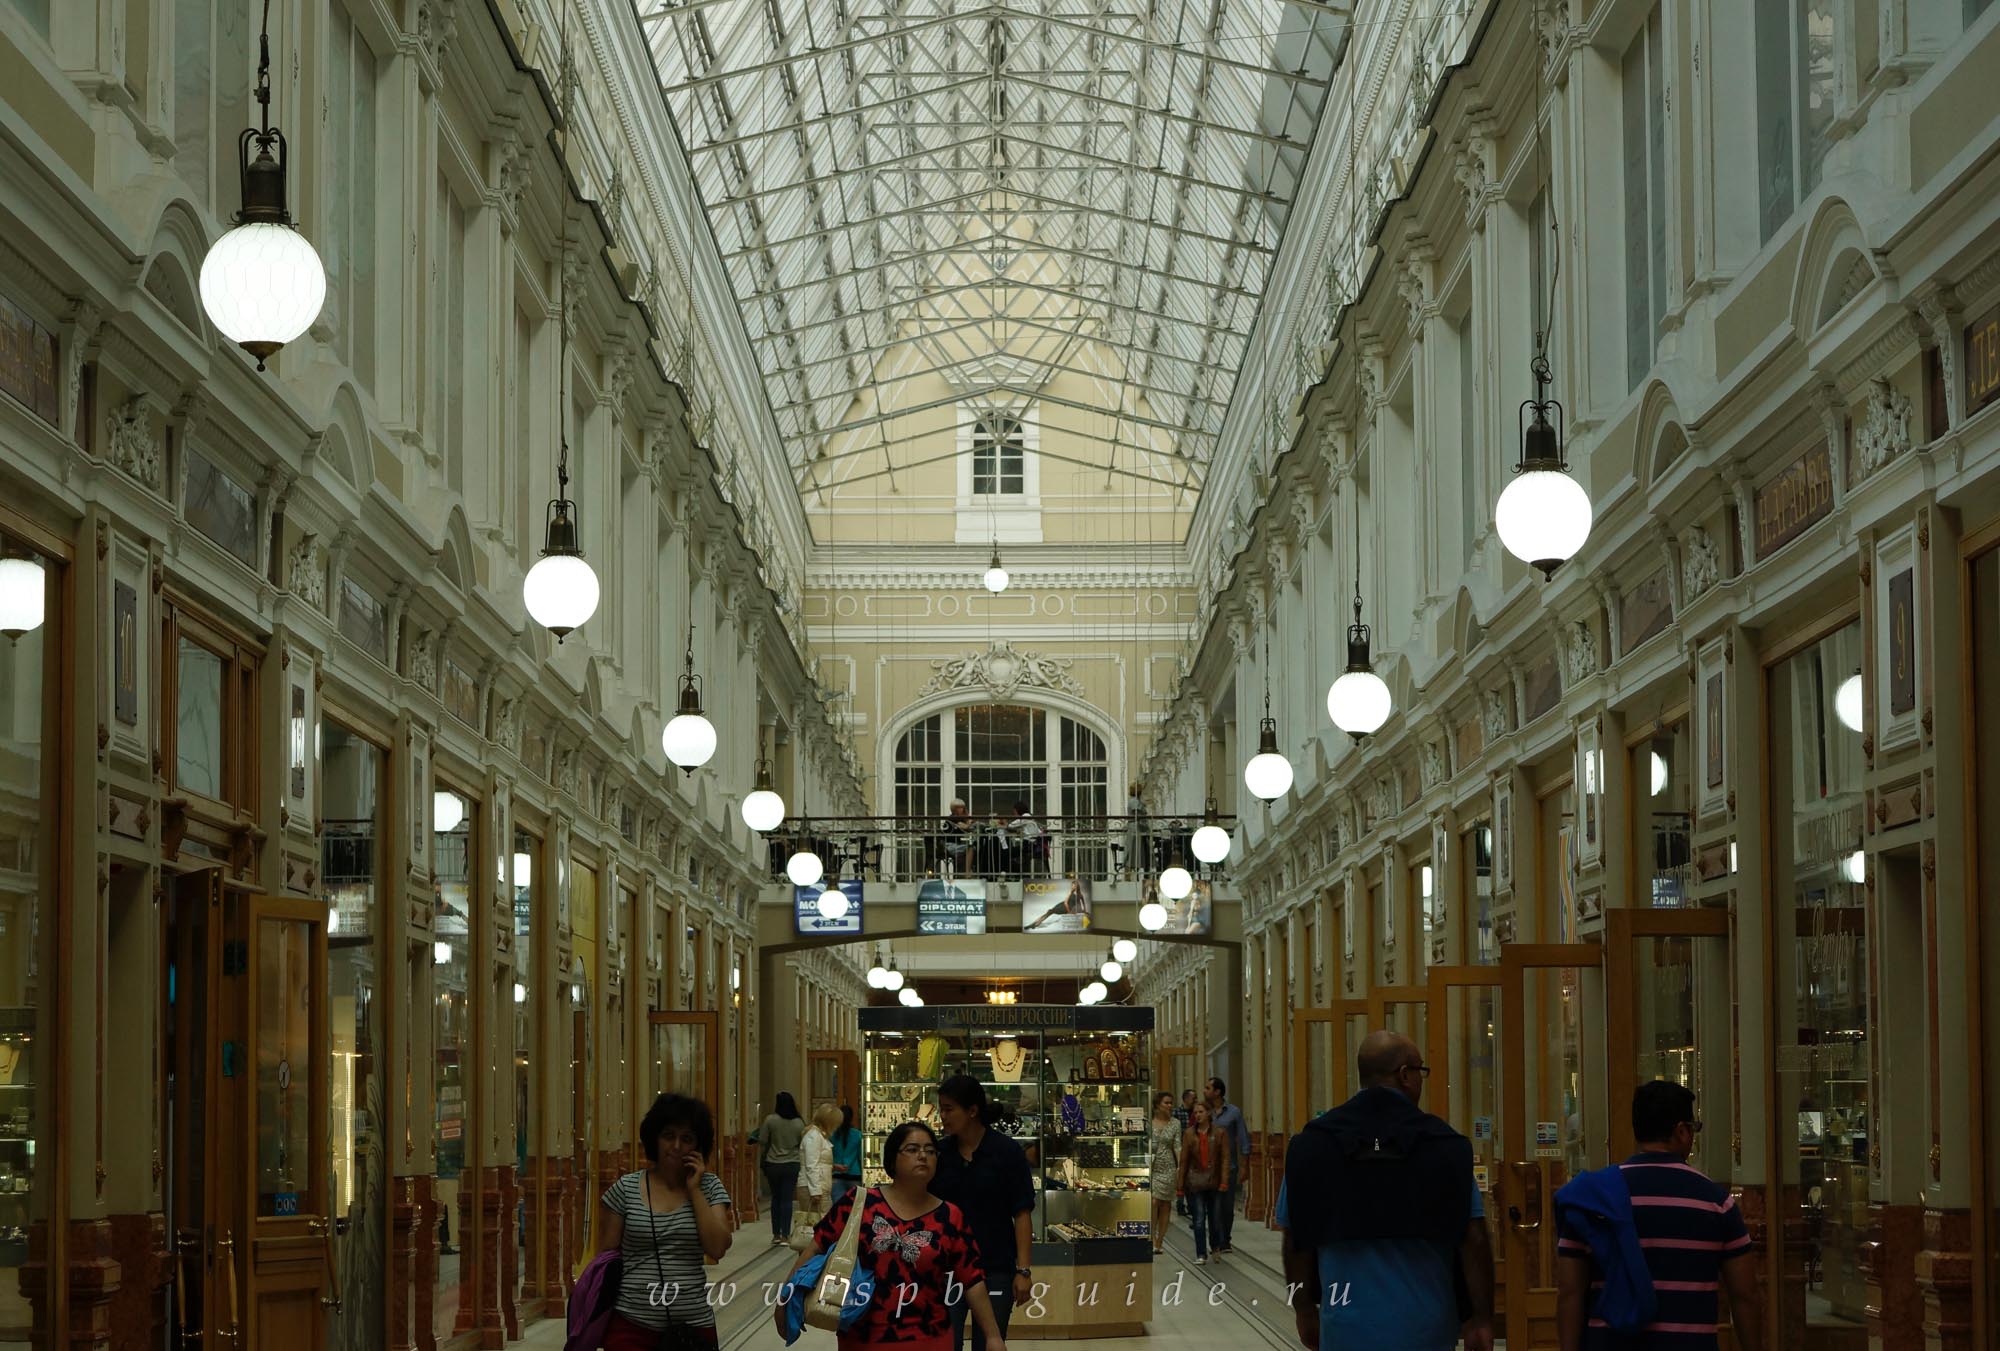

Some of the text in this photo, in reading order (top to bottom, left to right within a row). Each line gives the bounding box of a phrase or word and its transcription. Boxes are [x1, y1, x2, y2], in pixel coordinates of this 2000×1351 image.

[119, 609, 133, 694] 10
[1896, 601, 1906, 681] 9
[936, 921, 943, 930] 2
[944, 1007, 1069, 1025] САМОЦВЕТЫ РОССИИ
